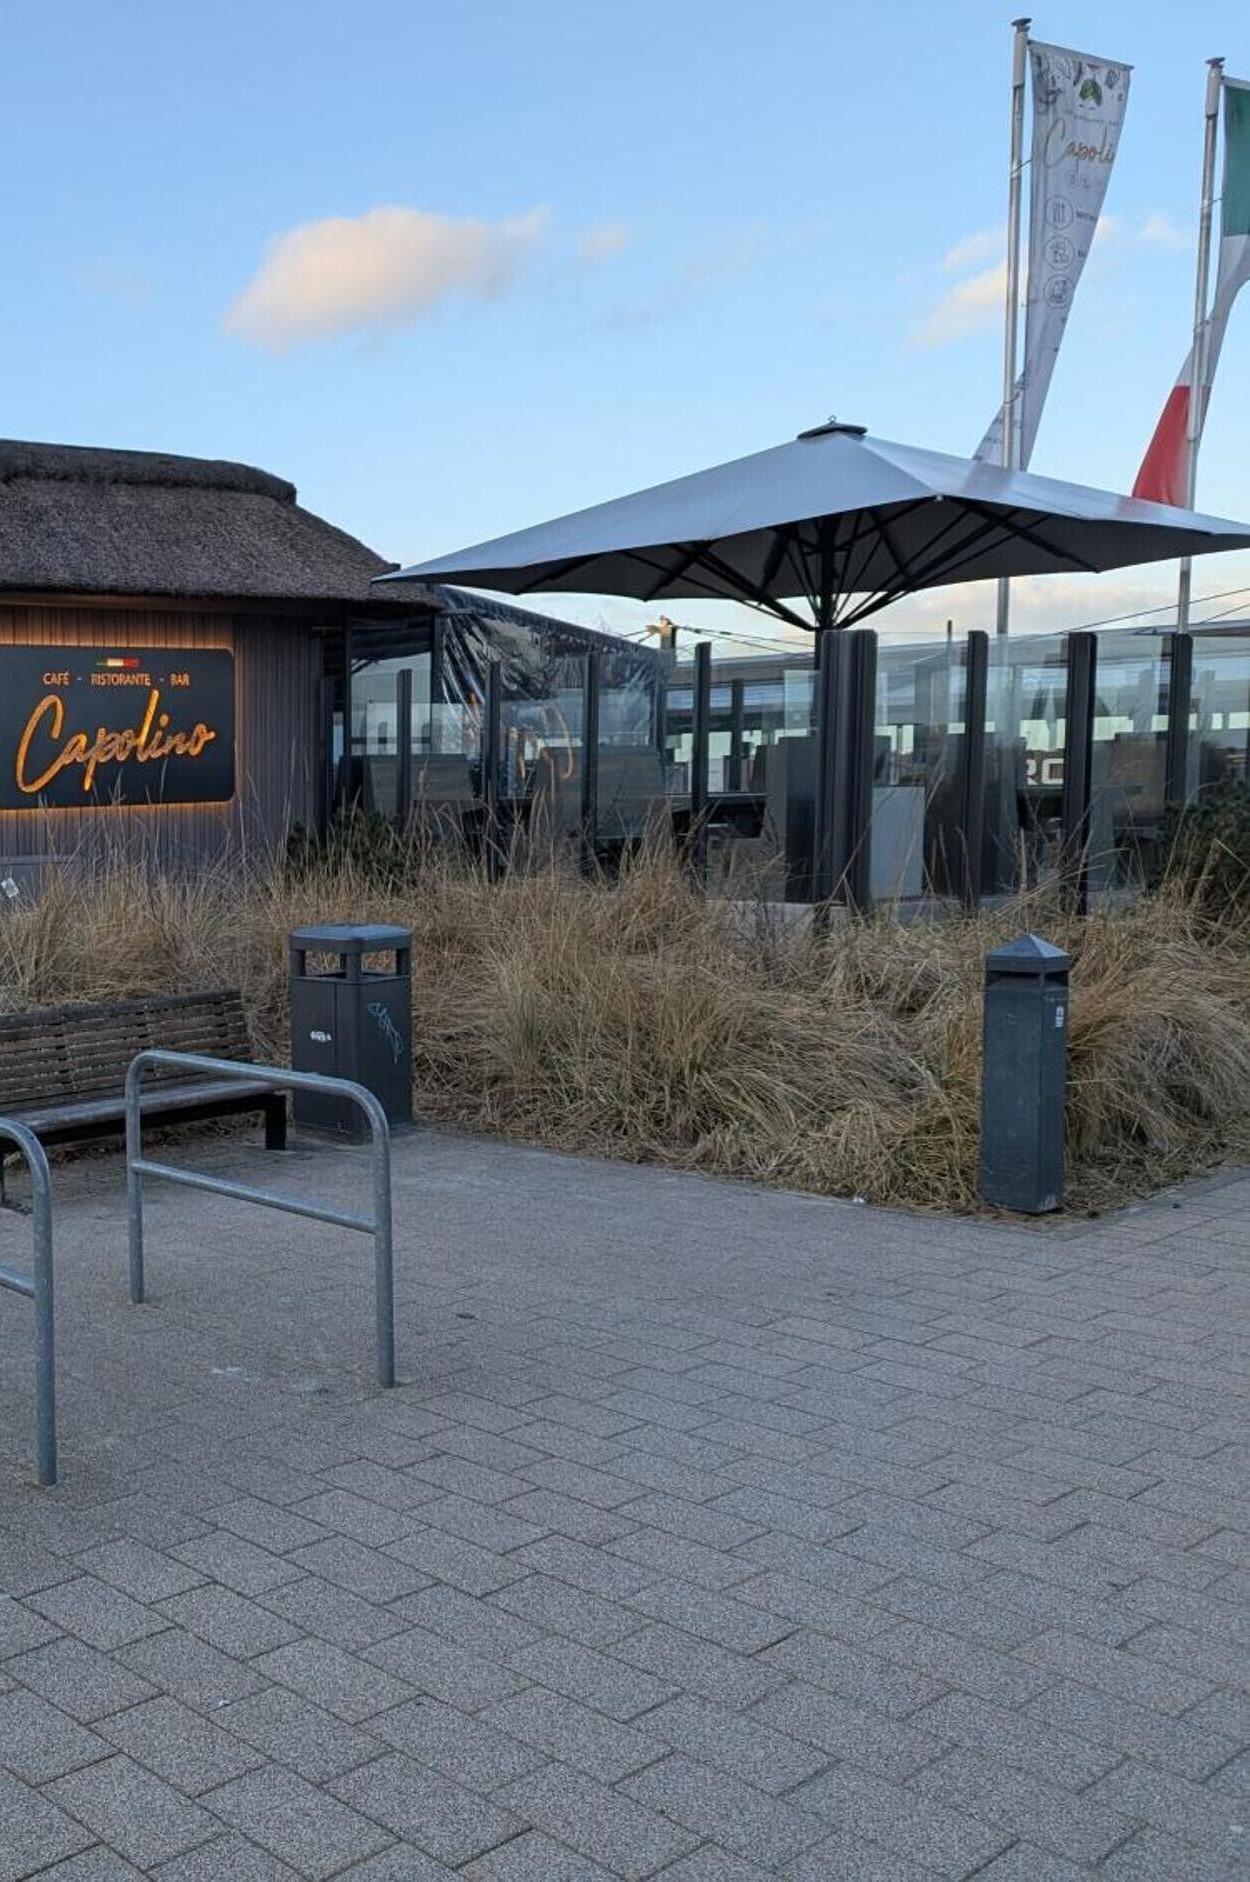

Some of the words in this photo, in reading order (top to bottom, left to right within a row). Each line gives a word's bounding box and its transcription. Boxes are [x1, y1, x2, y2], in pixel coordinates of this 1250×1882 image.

[42, 671, 70, 686] CAFÉ
[91, 673, 151, 686] RISTORANTE
[170, 674, 190, 687] BAR
[16, 688, 216, 793] Capolino
